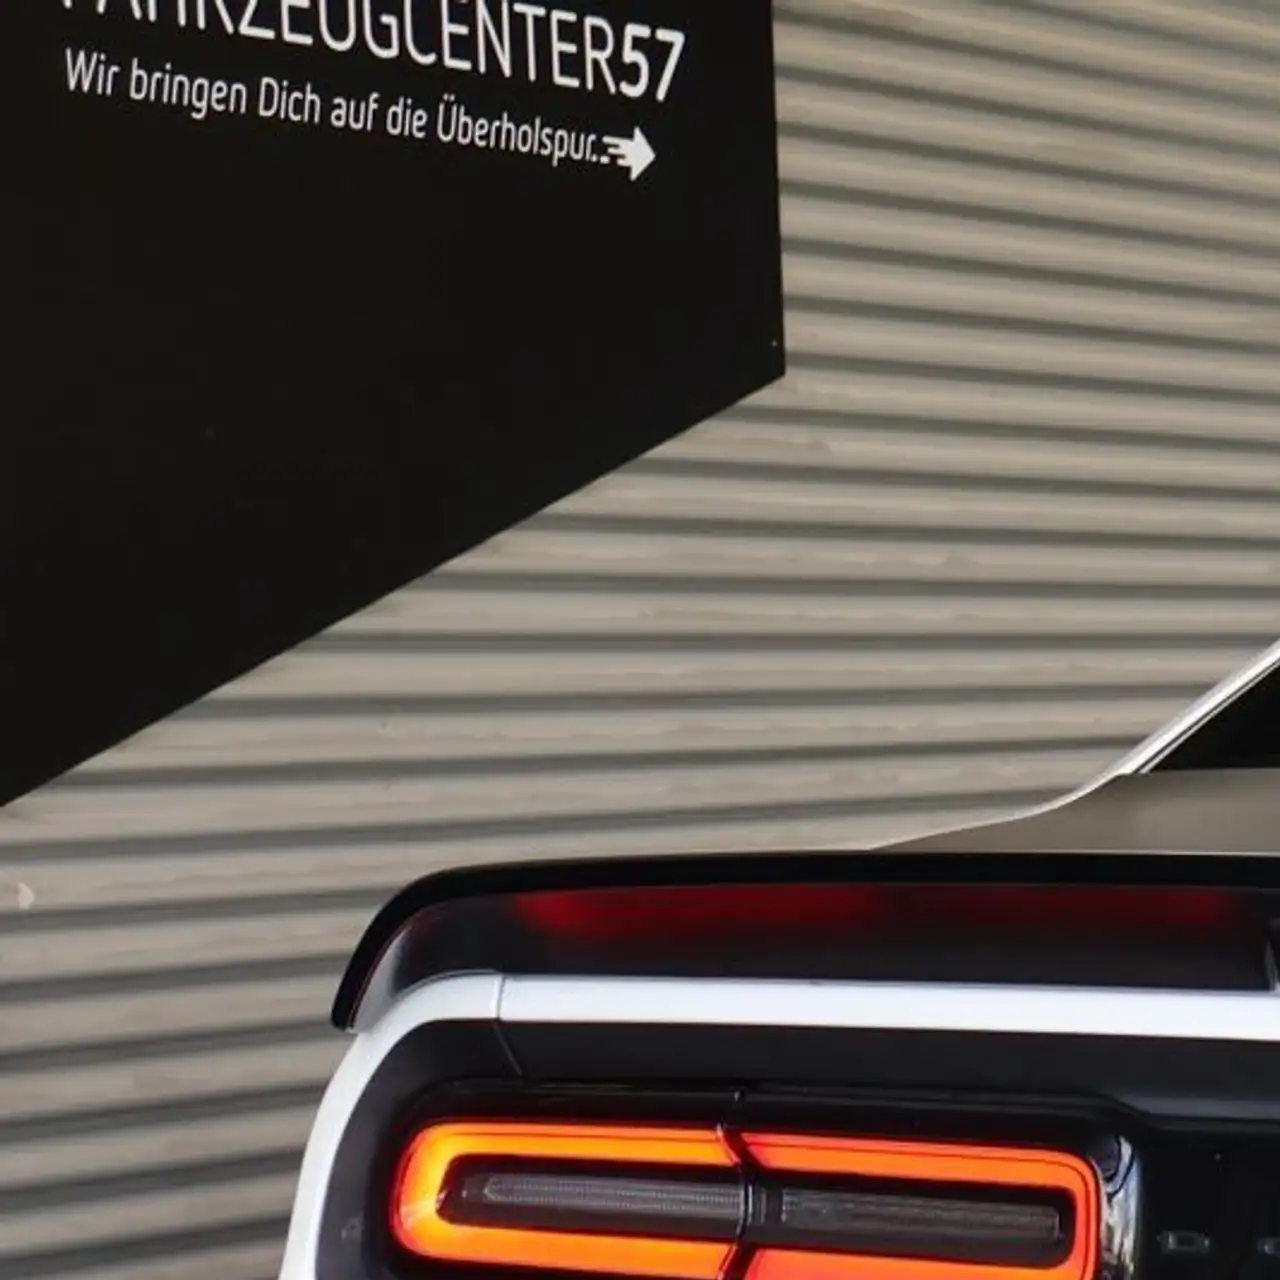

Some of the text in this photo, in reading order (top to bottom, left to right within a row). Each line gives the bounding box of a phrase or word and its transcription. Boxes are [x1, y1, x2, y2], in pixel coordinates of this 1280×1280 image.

[66, 48, 121, 95] Wir
[129, 57, 248, 120] bringen
[258, 76, 321, 124] Dich
[330, 92, 380, 131] auf
[386, 97, 428, 139] die
